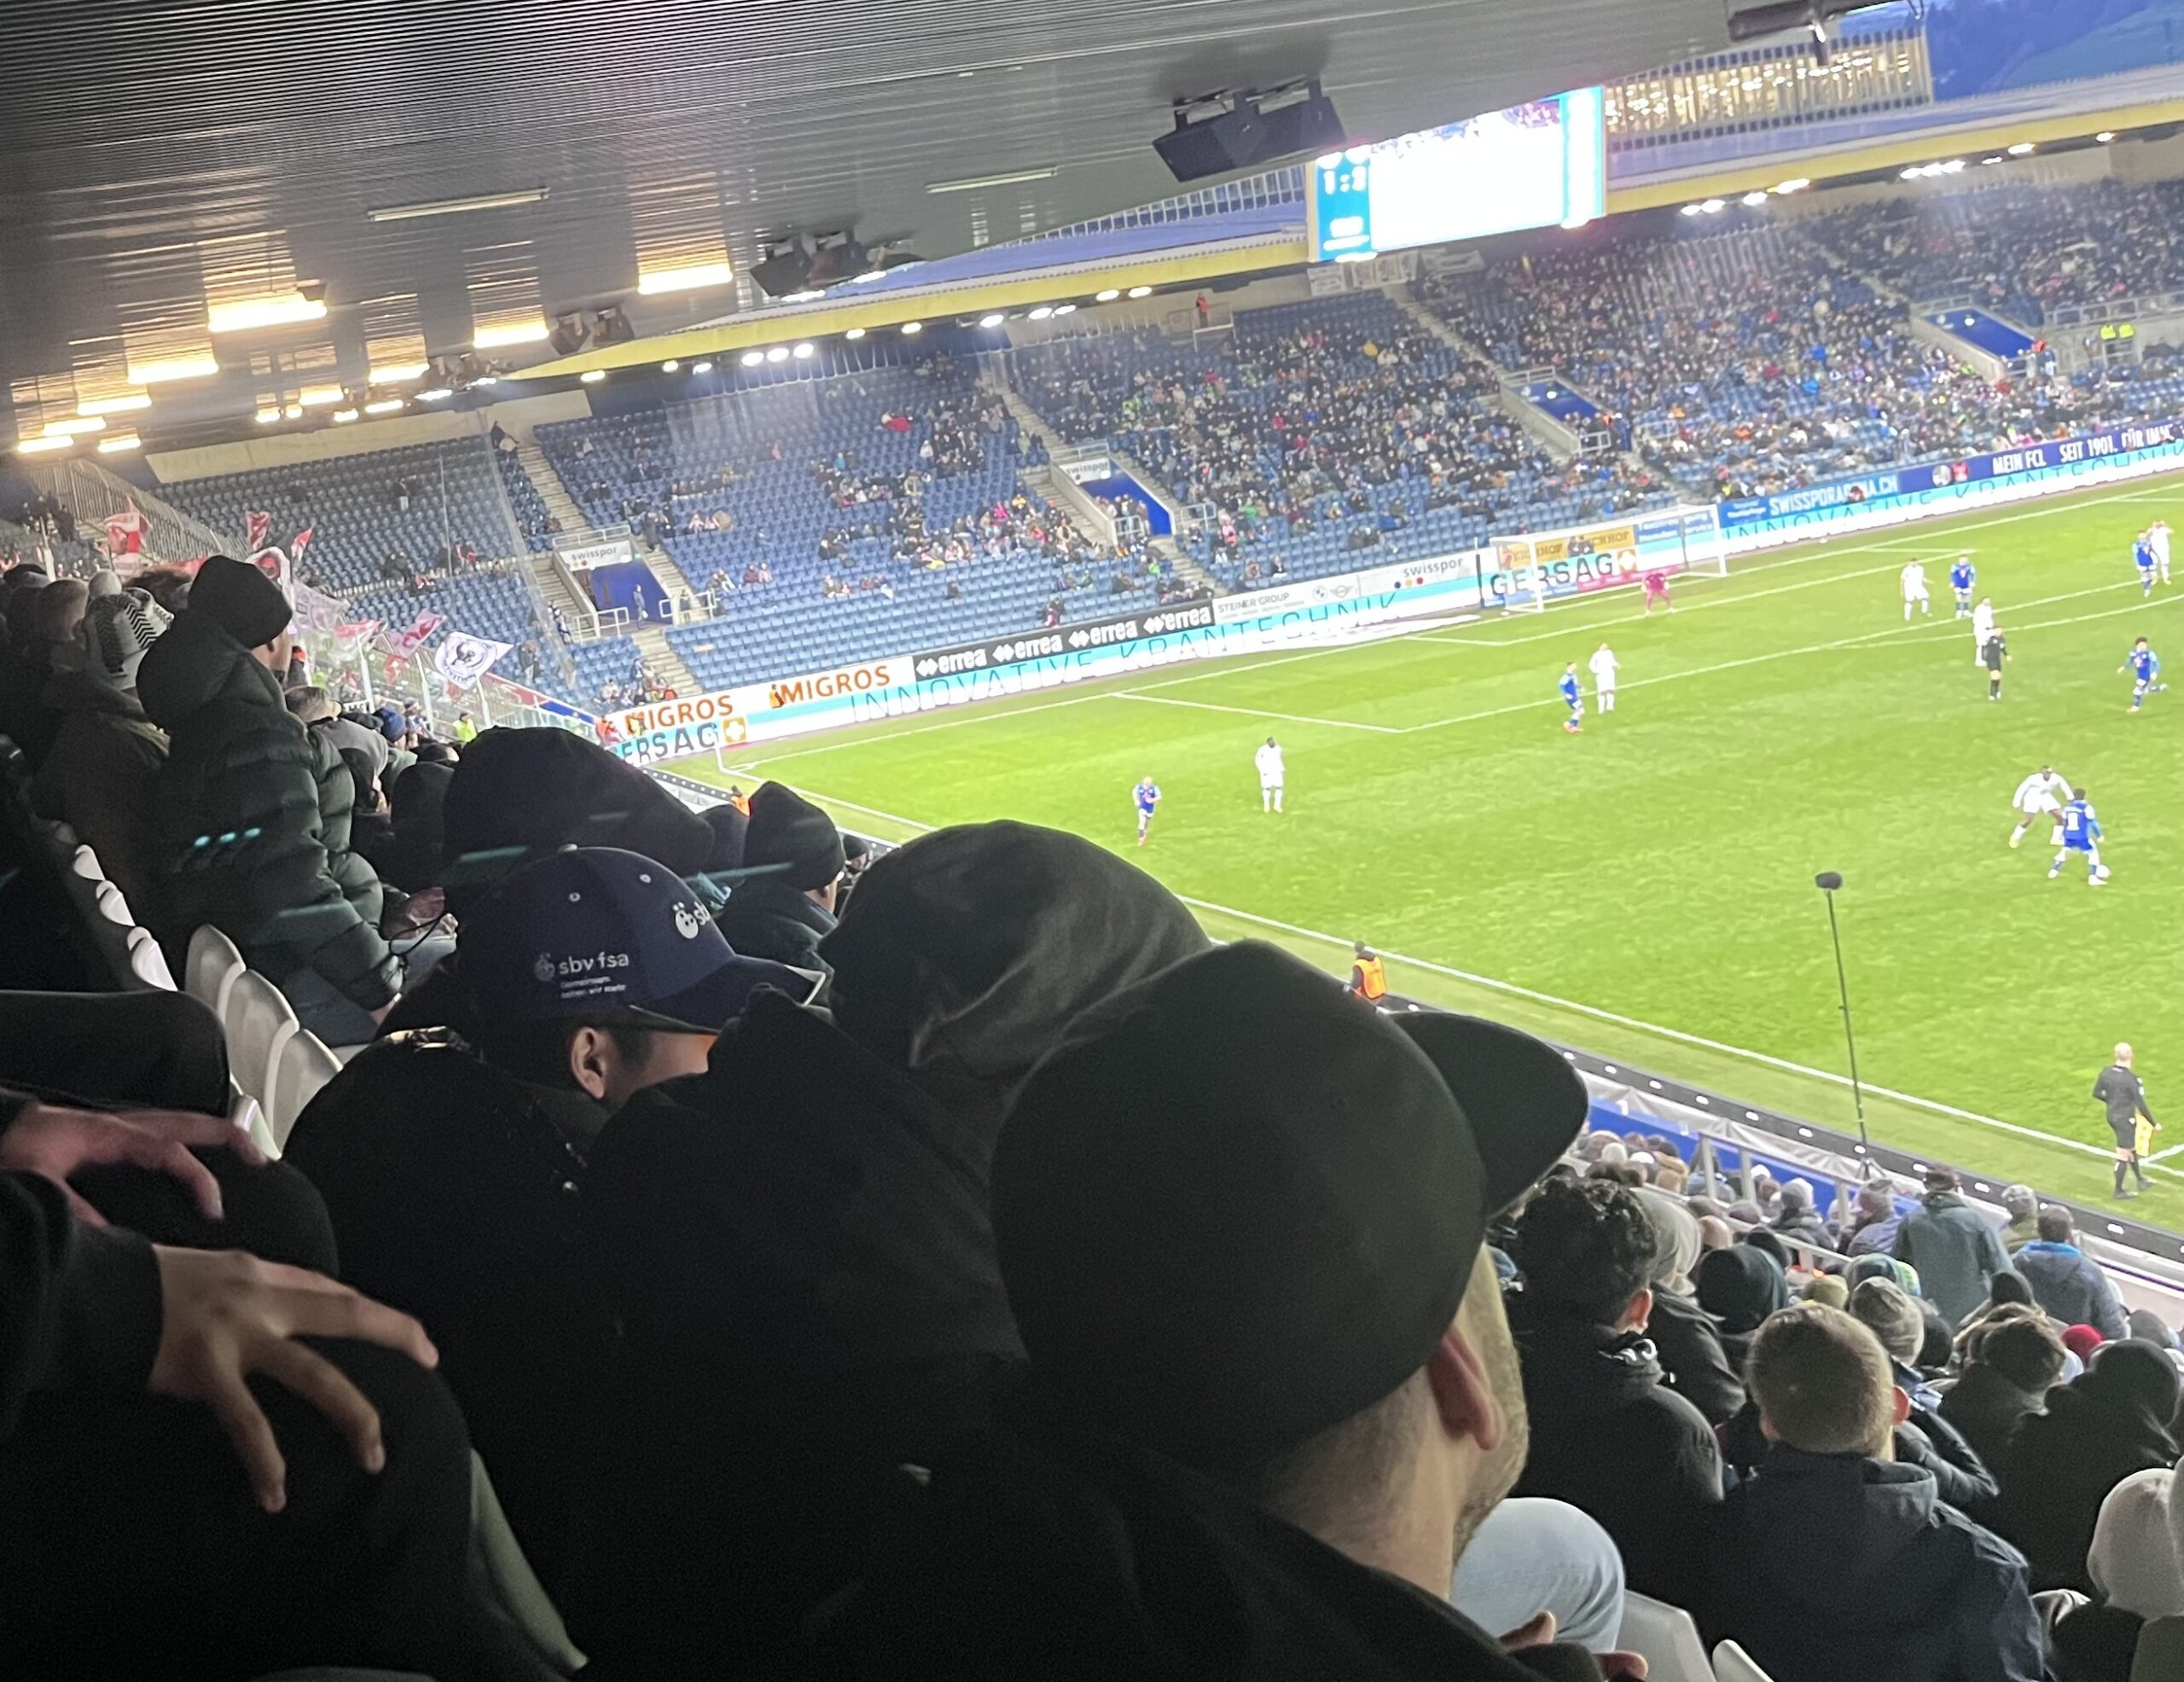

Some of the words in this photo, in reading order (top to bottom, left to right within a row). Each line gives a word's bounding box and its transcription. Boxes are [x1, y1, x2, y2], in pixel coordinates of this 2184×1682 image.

[1992, 453, 2023, 475] MEIN
[2059, 441, 2084, 462] SEIT
[1403, 557, 1464, 577] swisspor
[1490, 553, 1612, 594] GERSAG
[1258, 592, 1290, 606] GROUP
[781, 665, 890, 705] MIGROS
[624, 695, 734, 735] MIGROS
[611, 722, 718, 764] ERSAG
[559, 955, 595, 974] sbv
[597, 952, 630, 969] fsa
